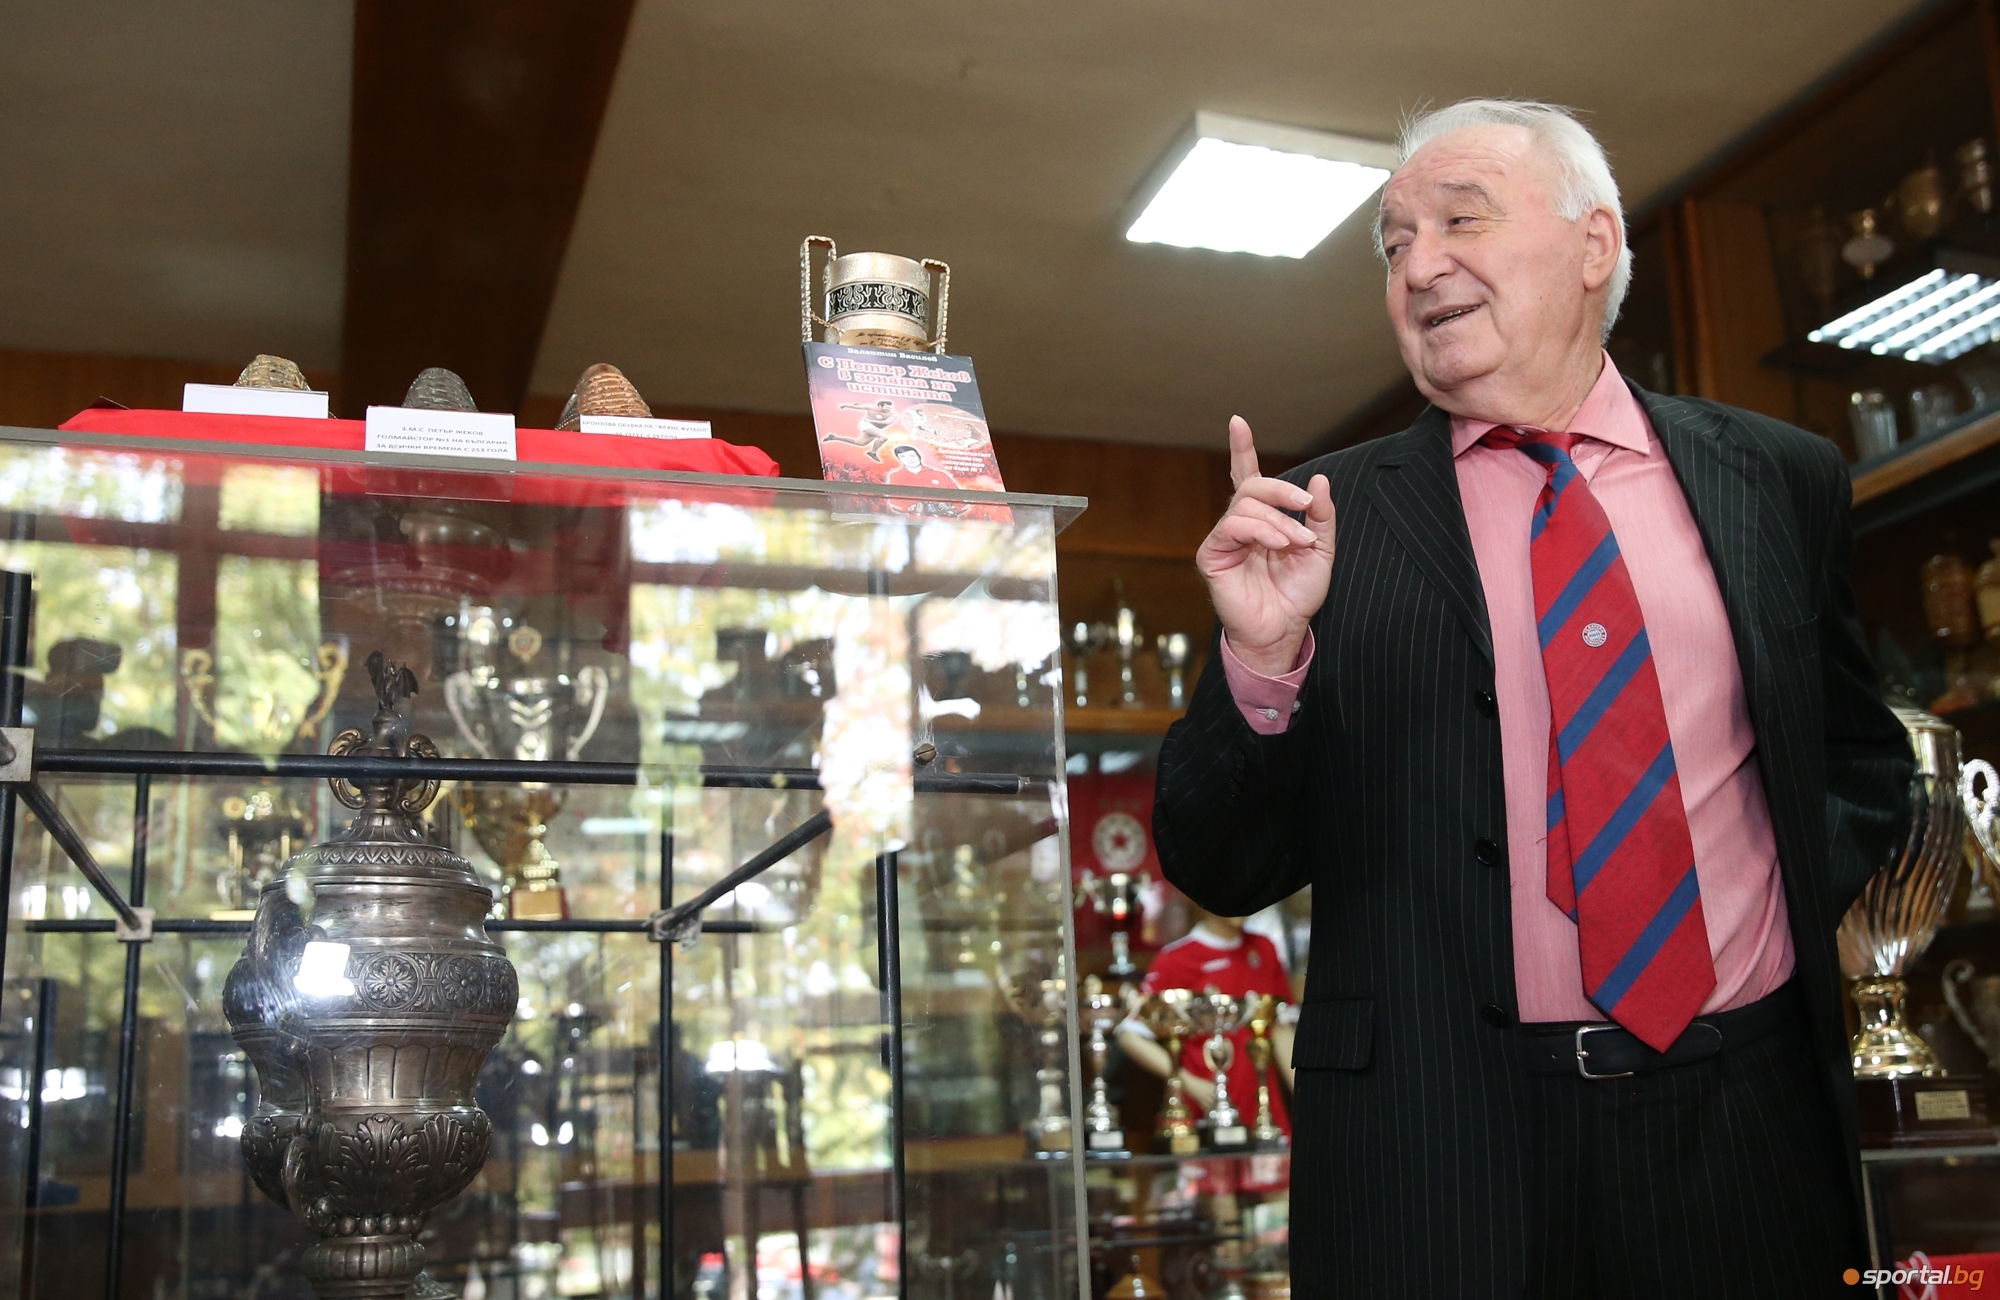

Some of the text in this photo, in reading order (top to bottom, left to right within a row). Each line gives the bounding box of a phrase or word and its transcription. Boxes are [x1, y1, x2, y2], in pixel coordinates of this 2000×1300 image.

[848, 348, 897, 358] Валентин
[819, 357, 971, 382] С Петър Жеков
[838, 370, 956, 392] в зоната на
[848, 382, 952, 401] истината
